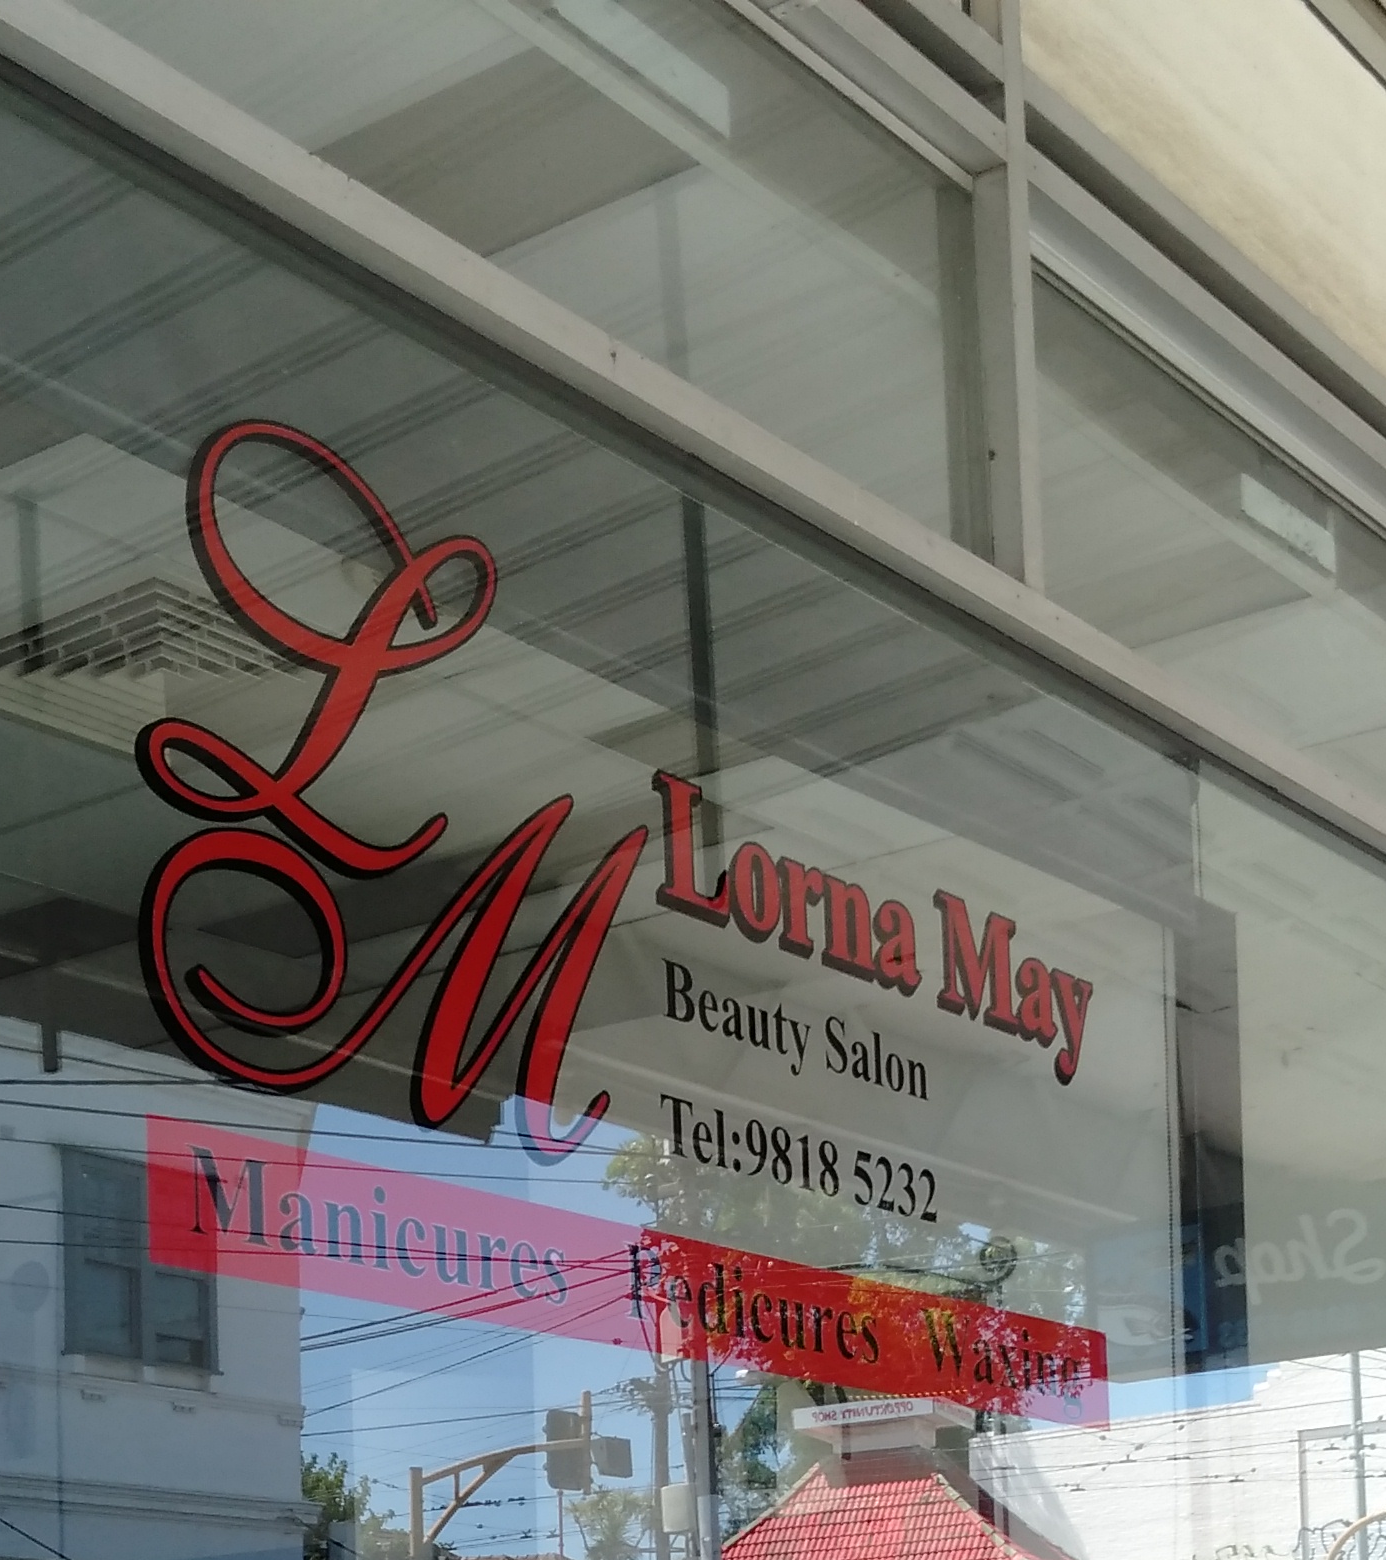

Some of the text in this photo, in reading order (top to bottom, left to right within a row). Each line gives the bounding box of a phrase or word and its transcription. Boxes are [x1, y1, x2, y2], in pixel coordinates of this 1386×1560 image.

[651, 771, 1092, 1085] Lorna May
[661, 958, 929, 1100] Beauty Salon
[660, 1094, 939, 1226] Tel:9818 5232
[189, 1145, 1084, 1419] Manicures Pedicures Waxing
